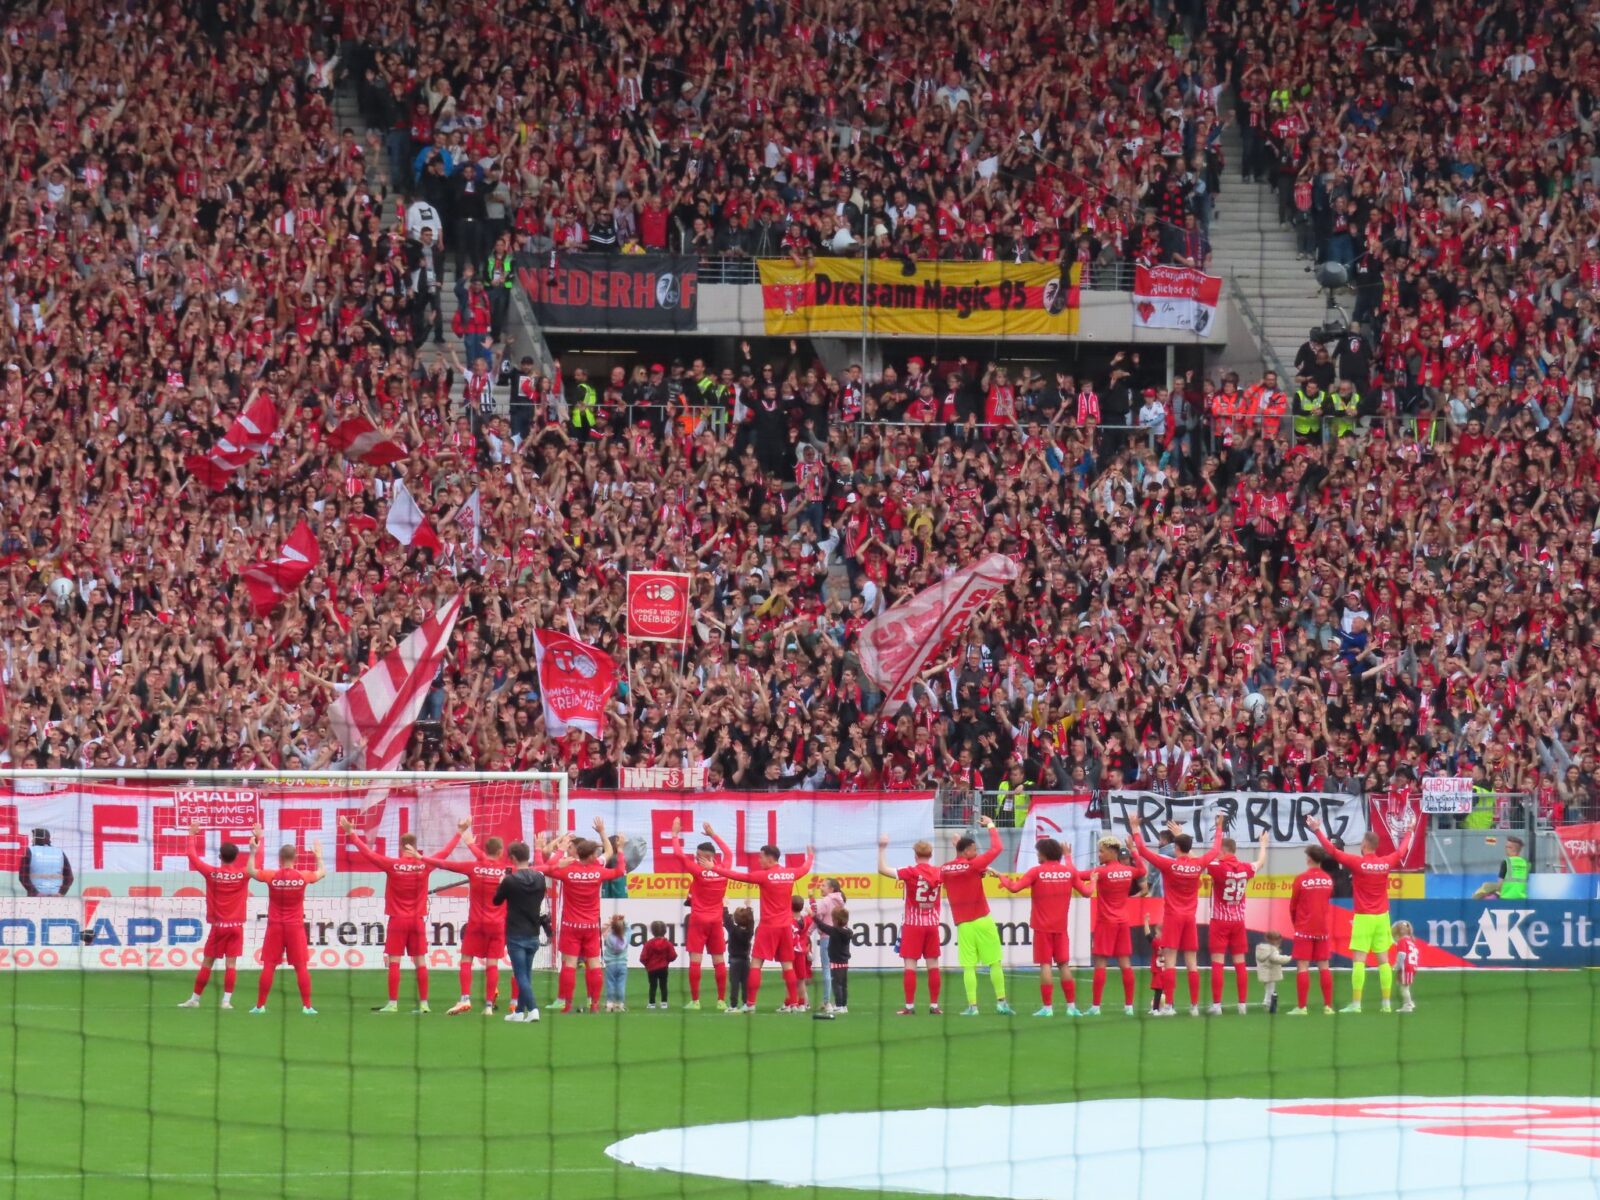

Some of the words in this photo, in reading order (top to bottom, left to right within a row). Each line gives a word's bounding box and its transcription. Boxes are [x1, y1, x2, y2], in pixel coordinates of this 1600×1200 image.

[923, 279, 991, 319] Magic
[1000, 280, 1027, 310] 95
[638, 614, 677, 625] FREIBURG
[179, 792, 255, 803] KHALID
[180, 803, 207, 814] FÜR
[210, 805, 255, 814] IMMER
[191, 815, 211, 824] BEI
[215, 815, 245, 824] UNS
[393, 864, 426, 872] CAZOO
[1171, 863, 1202, 873] CAZOO
[1360, 862, 1390, 870] CAZOO
[210, 872, 244, 881] CAZOO
[567, 871, 601, 880] CAZOO
[767, 873, 795, 881] CAZOO
[1039, 871, 1072, 879] CAZOO
[1107, 870, 1132, 879] CAZOO
[271, 879, 305, 887] CAZOO
[646, 877, 692, 891] LOTTO
[836, 876, 871, 889] OTTO
[1301, 878, 1334, 887] CAZOO
